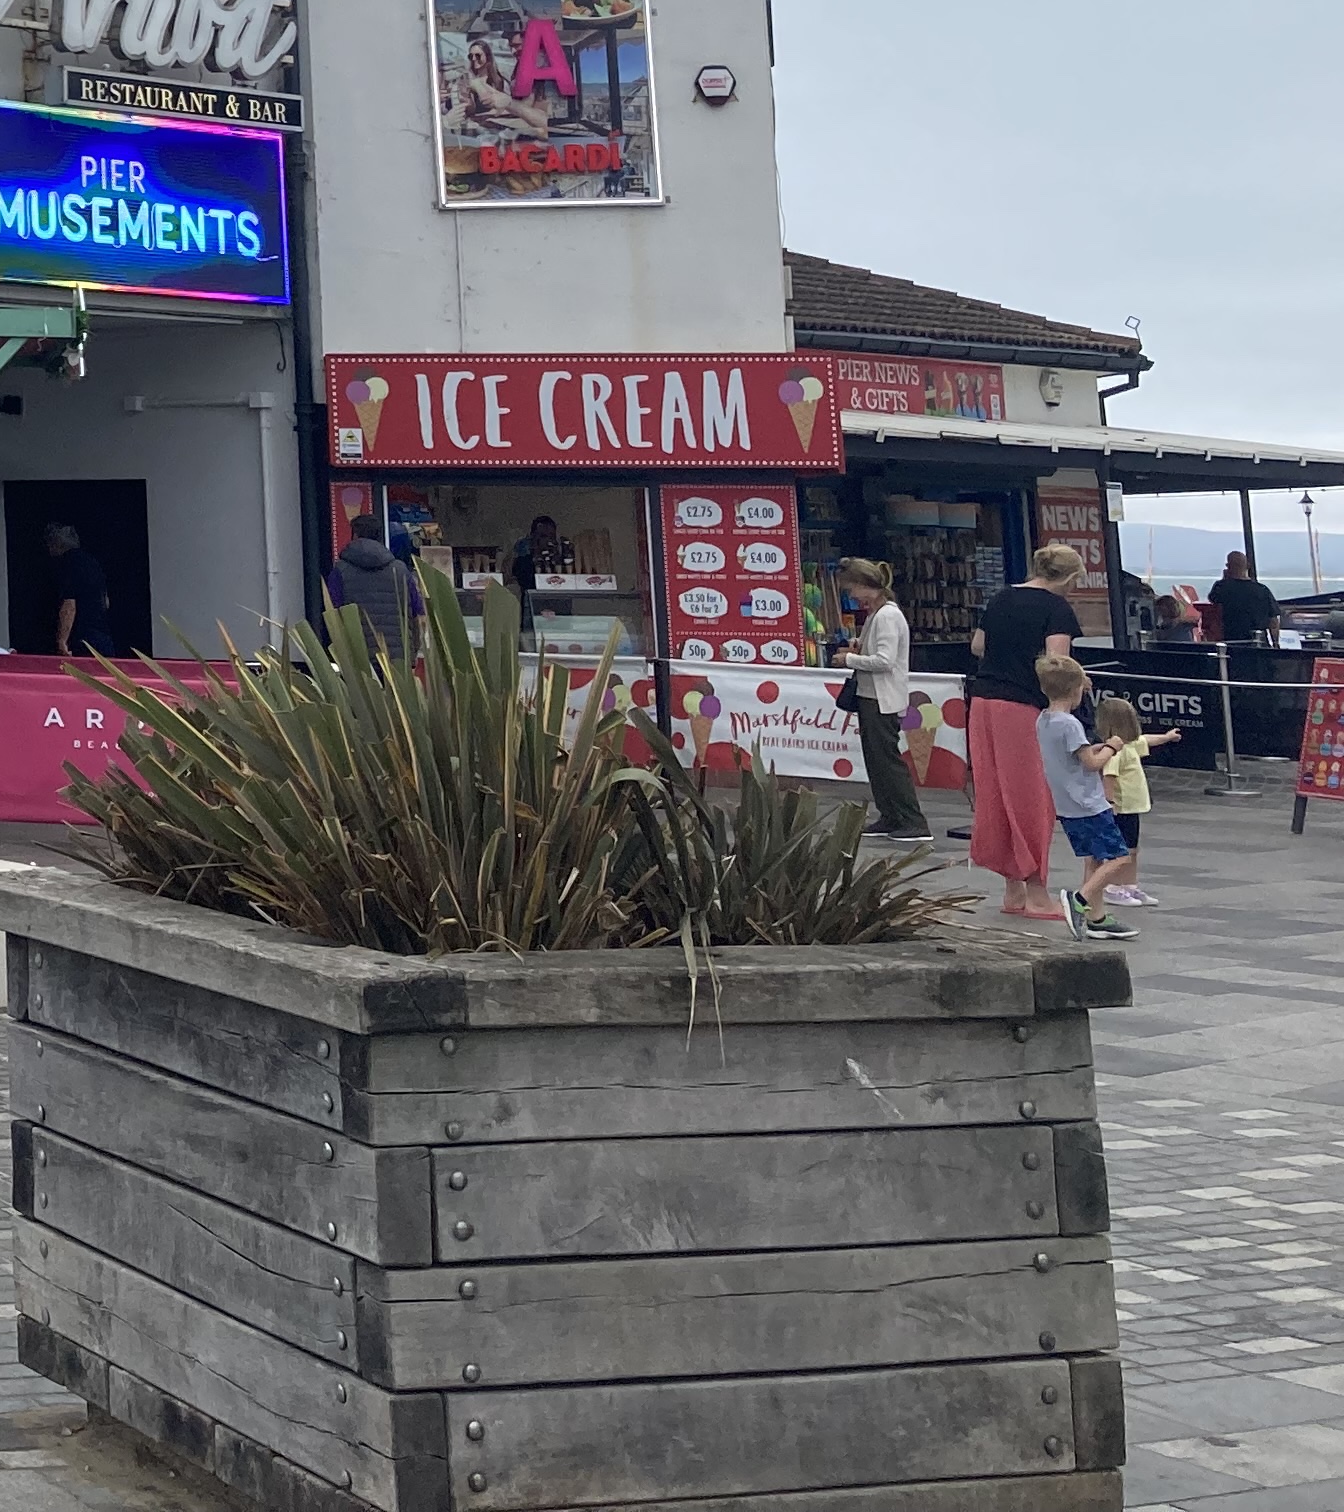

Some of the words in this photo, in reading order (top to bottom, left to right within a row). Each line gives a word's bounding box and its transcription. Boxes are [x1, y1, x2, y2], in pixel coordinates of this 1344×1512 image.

[80, 77, 215, 116] RESTAURANT
[225, 95, 240, 118] &
[248, 98, 288, 124] BAR
[80, 155, 146, 195] PIER
[837, 358, 872, 383] PIER
[874, 361, 921, 387] NEWS
[850, 387, 862, 409] &
[865, 388, 909, 412] GIFTS
[415, 370, 512, 450] ICE
[538, 367, 752, 455] CREAM
[686, 505, 713, 518] £2.75
[747, 507, 774, 519] £4.00
[1041, 504, 1101, 532] NEWS
[690, 551, 718, 563] £2.75
[750, 552, 777, 564] £4.00
[683, 593, 705, 603] £3.50
[706, 592, 717, 603] for
[690, 603, 700, 614] £6
[701, 603, 712, 614] for
[714, 603, 719, 614] 2
[754, 599, 782, 612] £3.00
[688, 644, 706, 659] 50p
[731, 645, 749, 660] 50p
[771, 646, 789, 660] 50p
[1137, 692, 1202, 715] GIFTS
[729, 706, 837, 740] Marshfield
[807, 739, 820, 749] ICE
